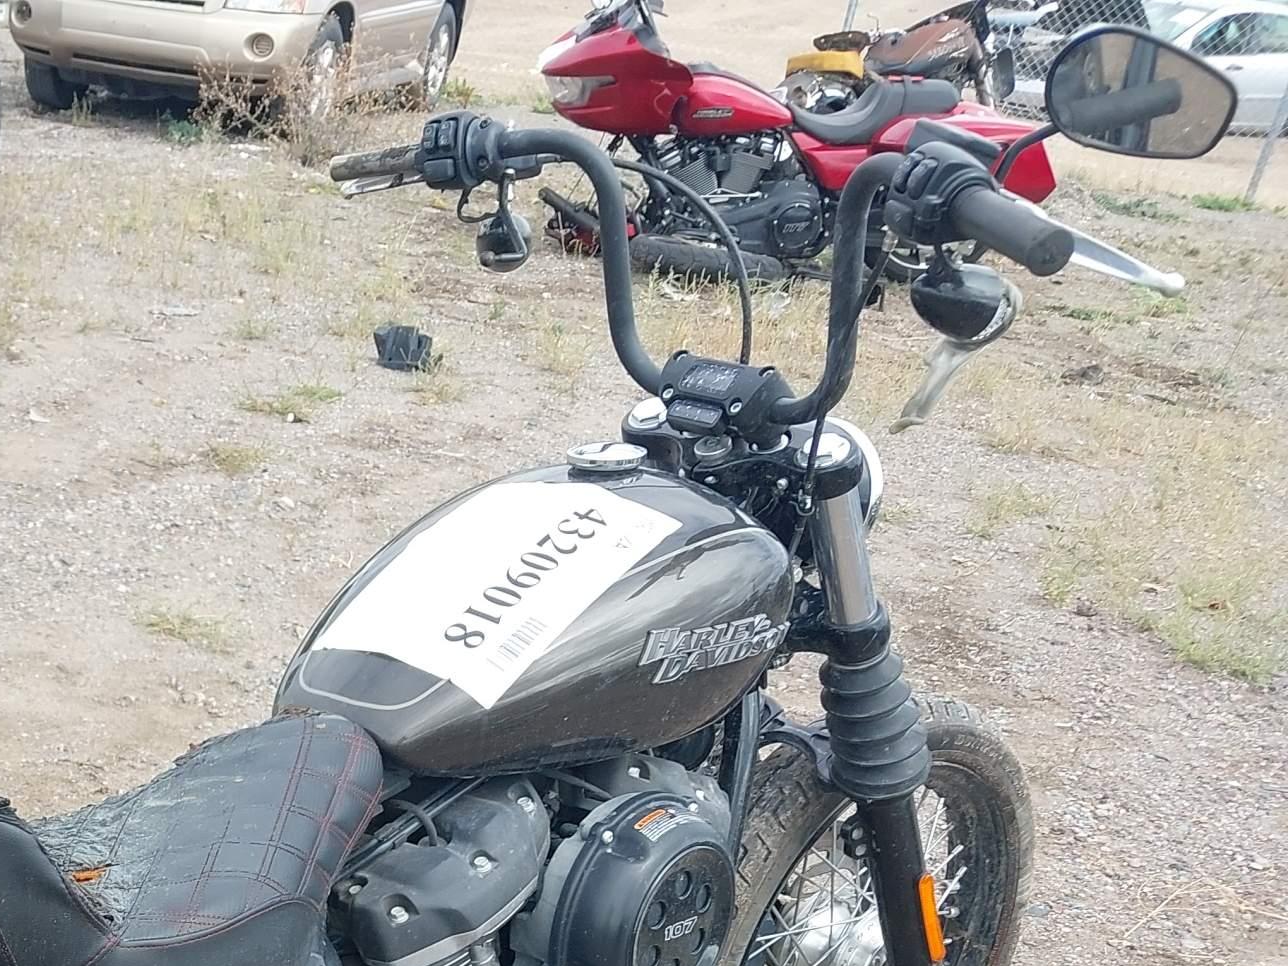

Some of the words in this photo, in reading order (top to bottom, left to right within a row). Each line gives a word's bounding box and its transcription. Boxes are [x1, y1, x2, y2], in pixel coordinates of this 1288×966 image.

[444, 508, 607, 649] 43209018
[651, 621, 791, 684] DAVIDSON
[665, 916, 699, 941] 107
